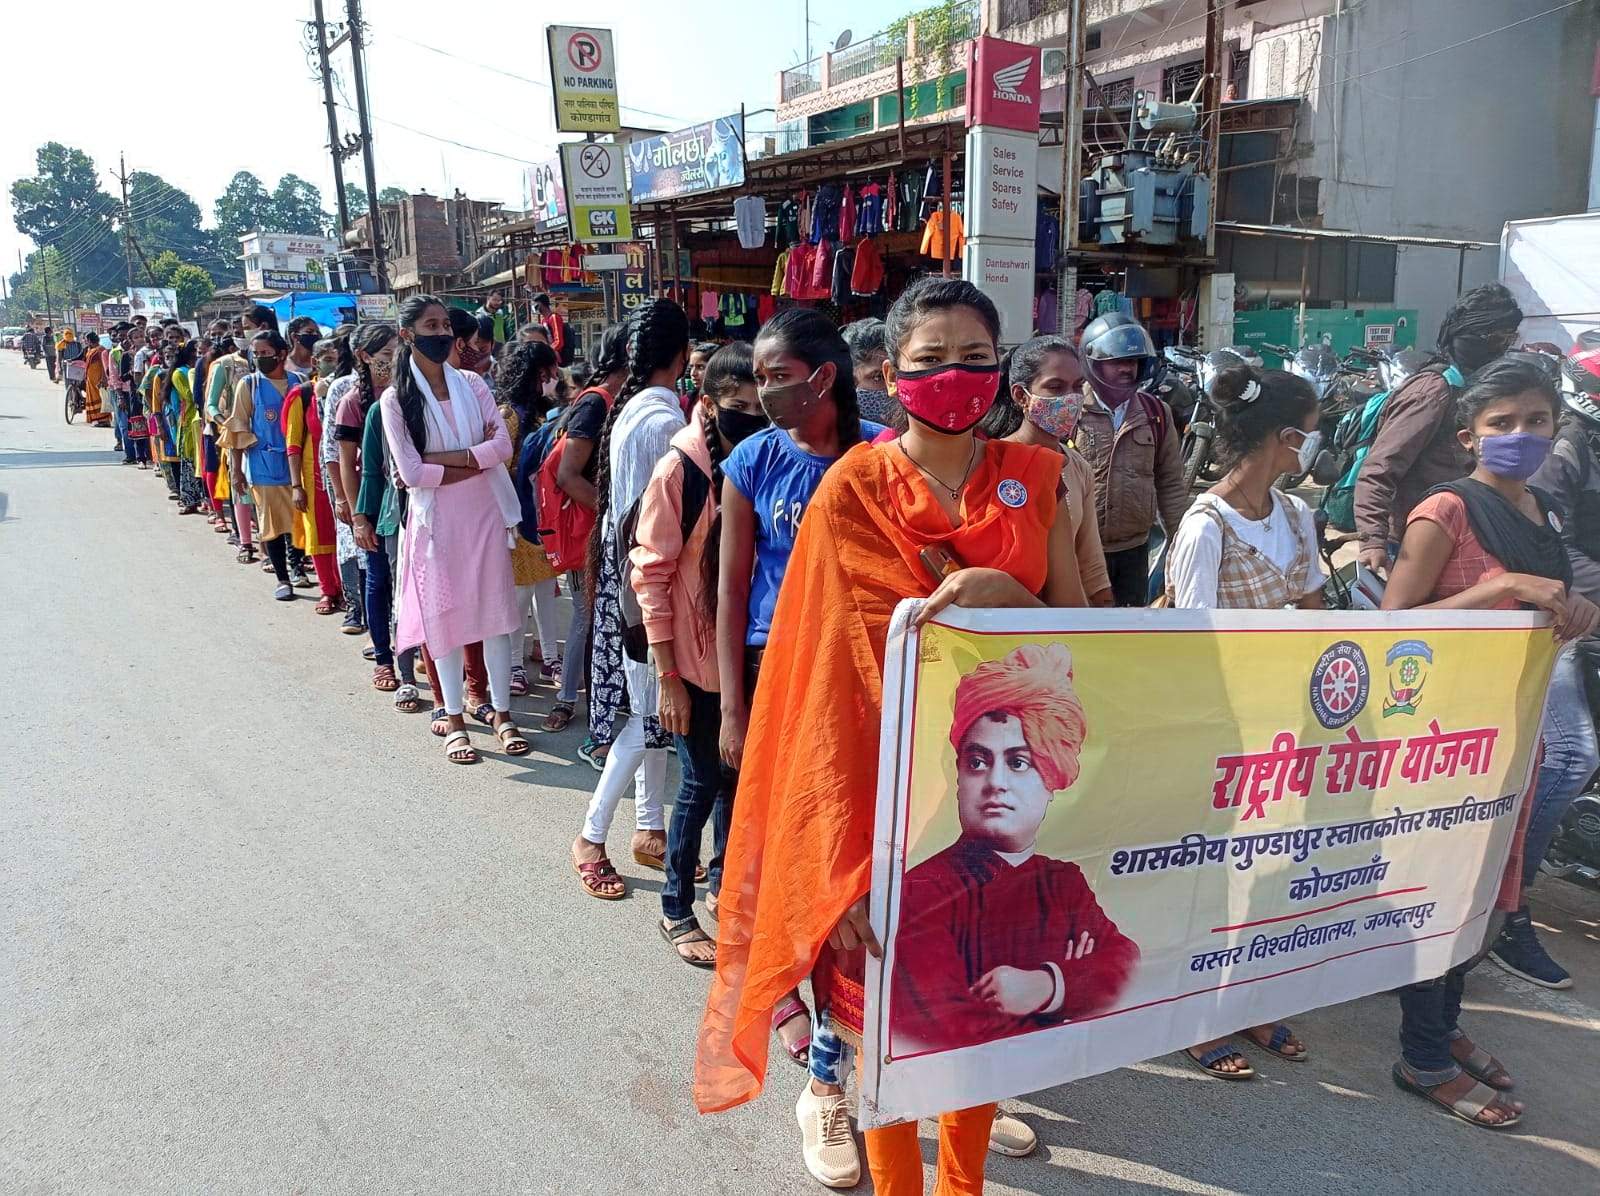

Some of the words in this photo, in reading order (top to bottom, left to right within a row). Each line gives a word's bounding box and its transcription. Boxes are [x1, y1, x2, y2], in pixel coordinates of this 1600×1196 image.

[564, 77, 576, 87] NO
[577, 78, 613, 89] PARKING
[993, 90, 1032, 104] HONDA
[652, 126, 705, 168] गोलछा
[993, 147, 1016, 160] Sales
[992, 164, 1024, 178] Service
[992, 181, 1022, 197] Spares
[991, 198, 1018, 213] Safety
[590, 210, 614, 225] GK
[592, 227, 615, 235] TMT
[985, 258, 1030, 270] Danteshwari
[985, 273, 1009, 283] Honda
[1337, 644, 1352, 655] सेवा
[1312, 686, 1328, 724] NATIONAL
[1327, 715, 1351, 726] SERVICE
[1351, 685, 1367, 717] SCHEME
[1213, 732, 1323, 821] राष्ट्रीय
[1325, 725, 1401, 794] सेवा
[1400, 719, 1499, 784] योजना
[1110, 833, 1228, 875] शासकीय
[1231, 827, 1324, 871] गुण्डाधुर
[1325, 807, 1425, 847] स्नातकोत्तर
[1426, 796, 1517, 831] महाविद्यालय
[1289, 854, 1391, 901] कोण्डागाँव
[1190, 945, 1245, 972] बस्तर
[1247, 919, 1357, 962] विश्वविद्यालय,
[1363, 901, 1437, 931] जगदलपुर
